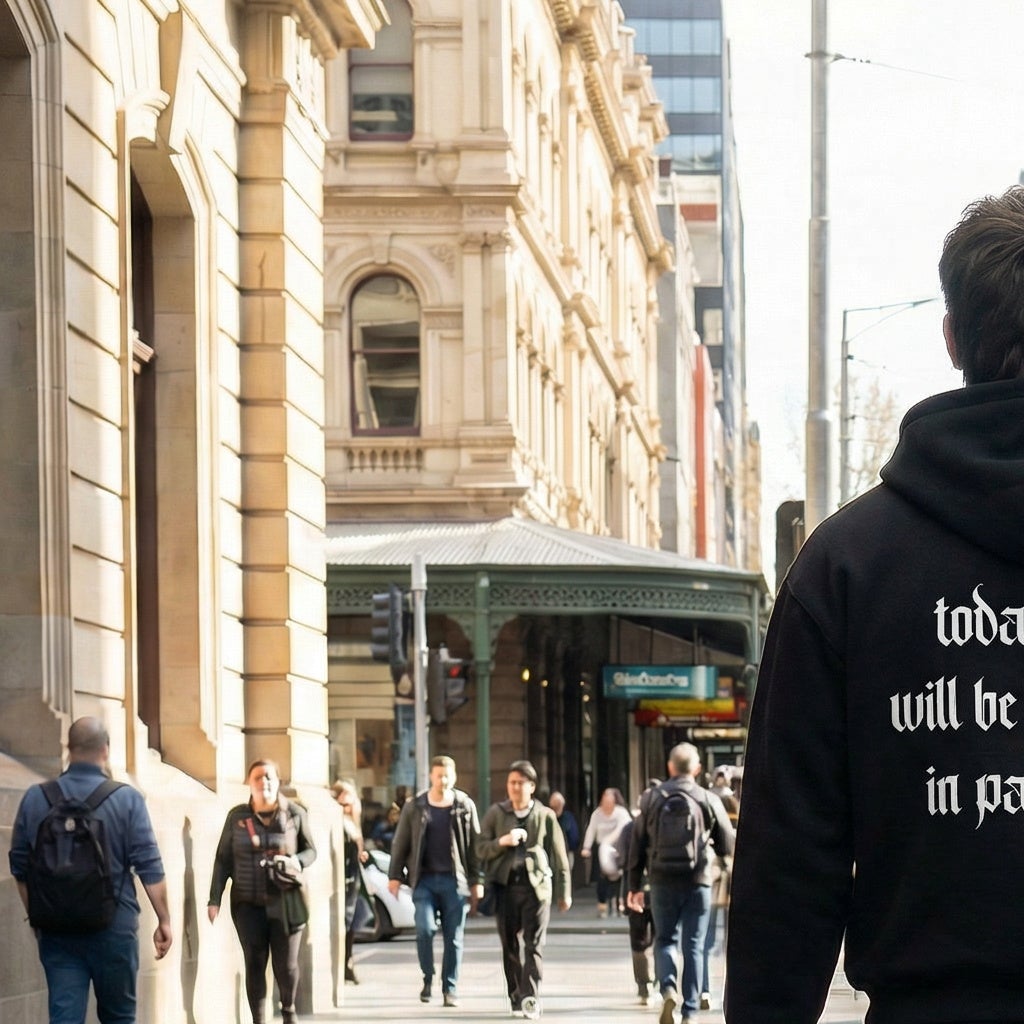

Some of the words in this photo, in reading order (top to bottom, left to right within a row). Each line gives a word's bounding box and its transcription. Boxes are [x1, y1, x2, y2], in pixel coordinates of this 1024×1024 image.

[890, 675, 963, 732] will
[974, 676, 1017, 731] be
[926, 766, 962, 816] in
